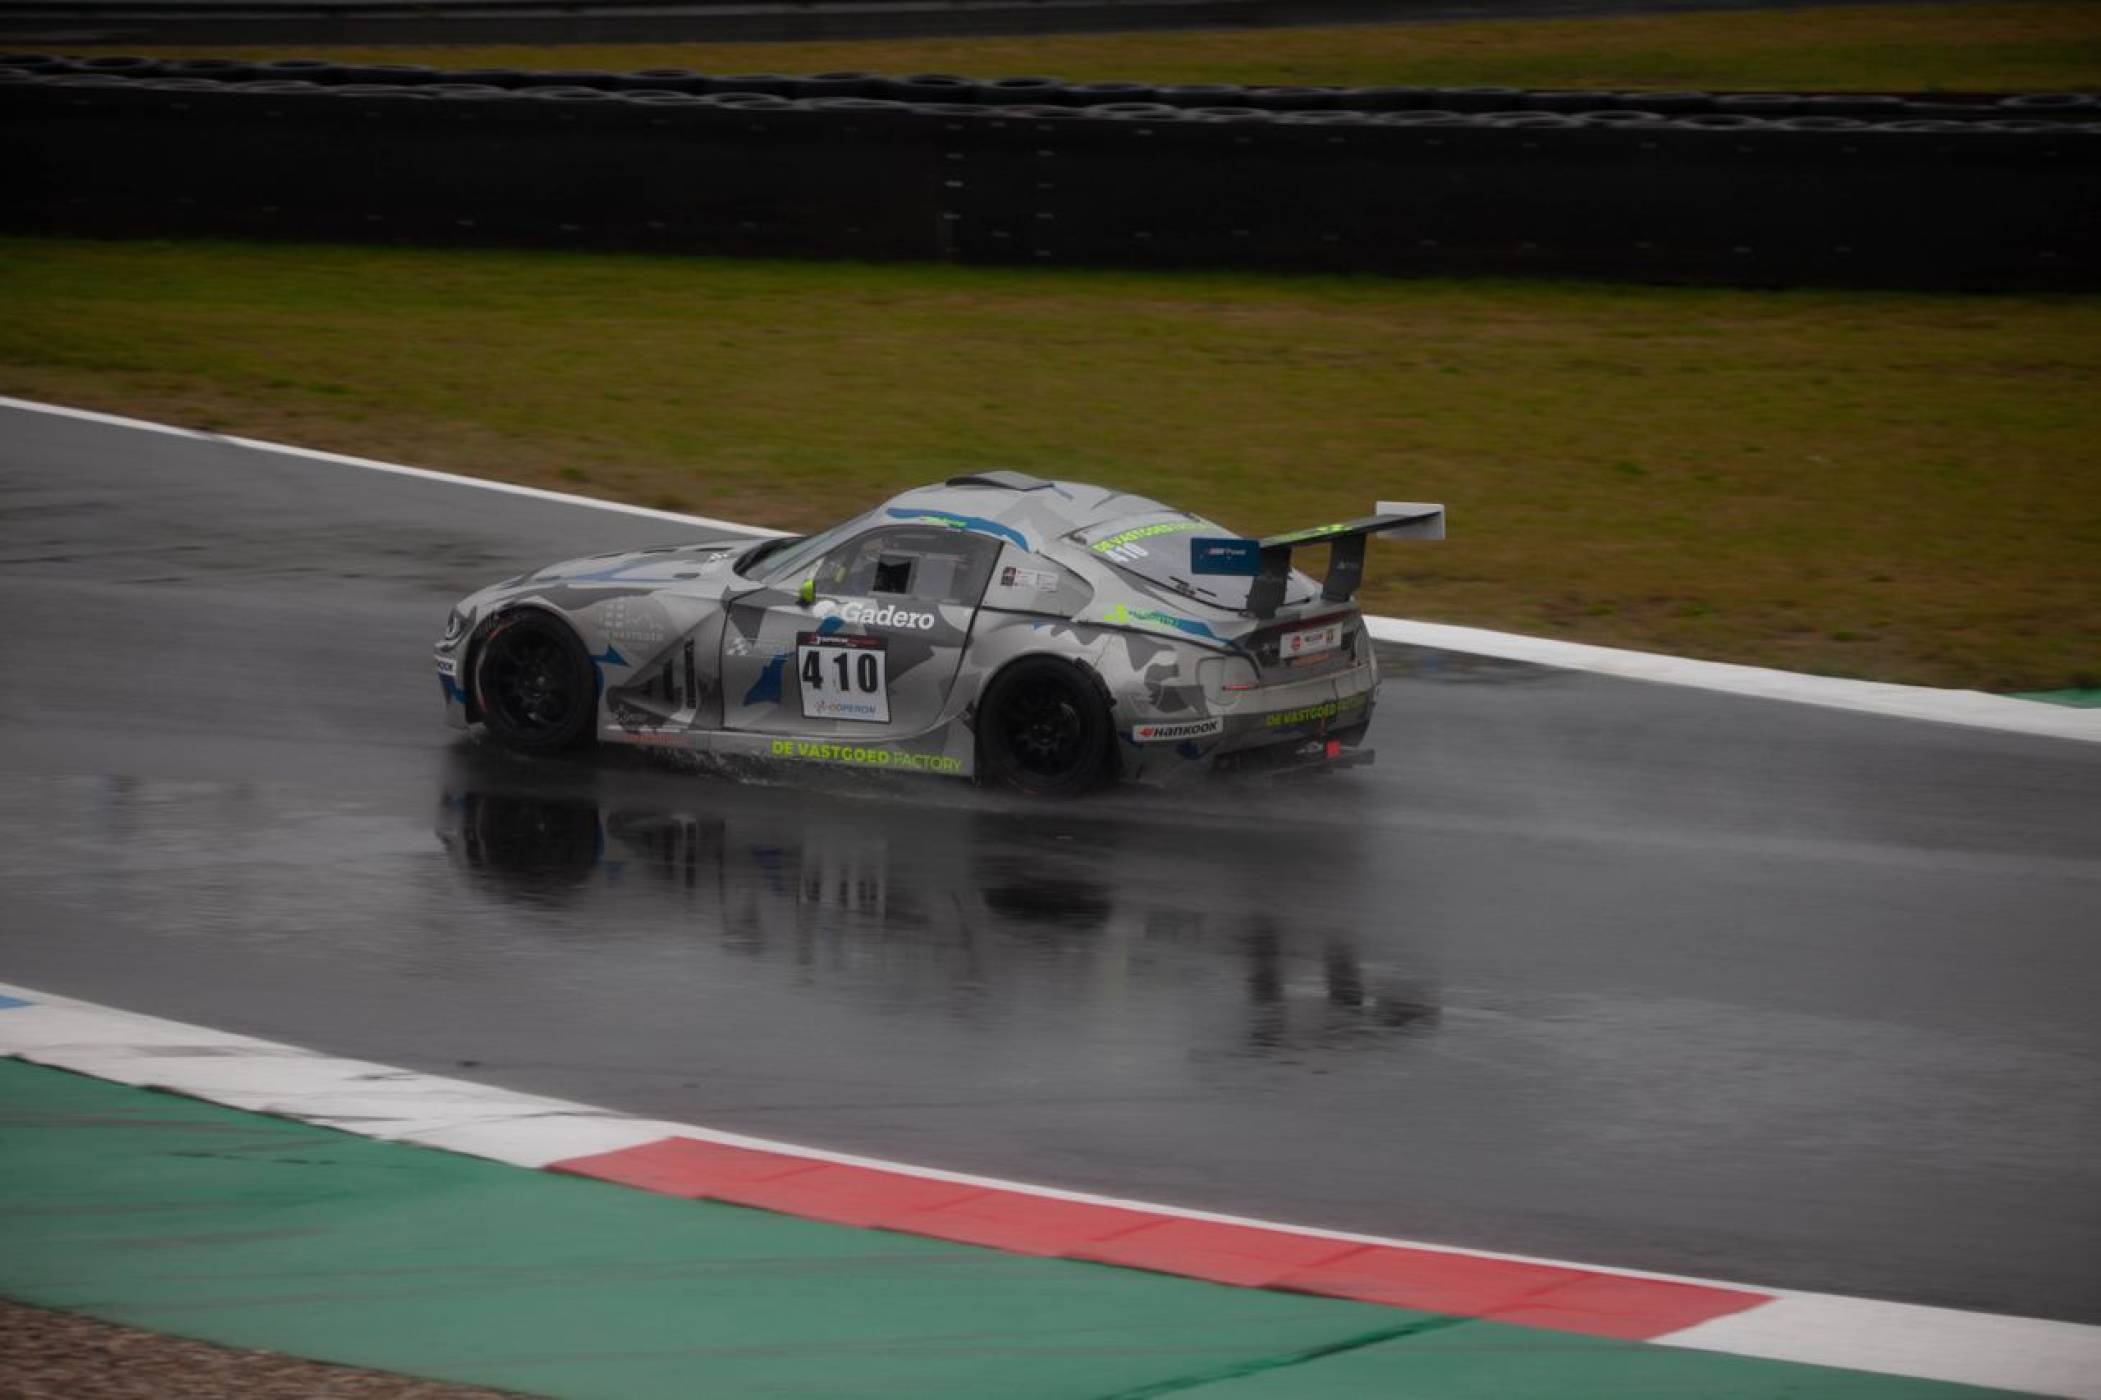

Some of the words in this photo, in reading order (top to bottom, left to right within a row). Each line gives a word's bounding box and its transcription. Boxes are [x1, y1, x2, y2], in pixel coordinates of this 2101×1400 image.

[840, 602, 935, 630] Gadero
[801, 650, 878, 693] 410
[771, 740, 793, 756] DE
[797, 742, 889, 764] VASTGOED
[893, 752, 963, 773] FACTORY
